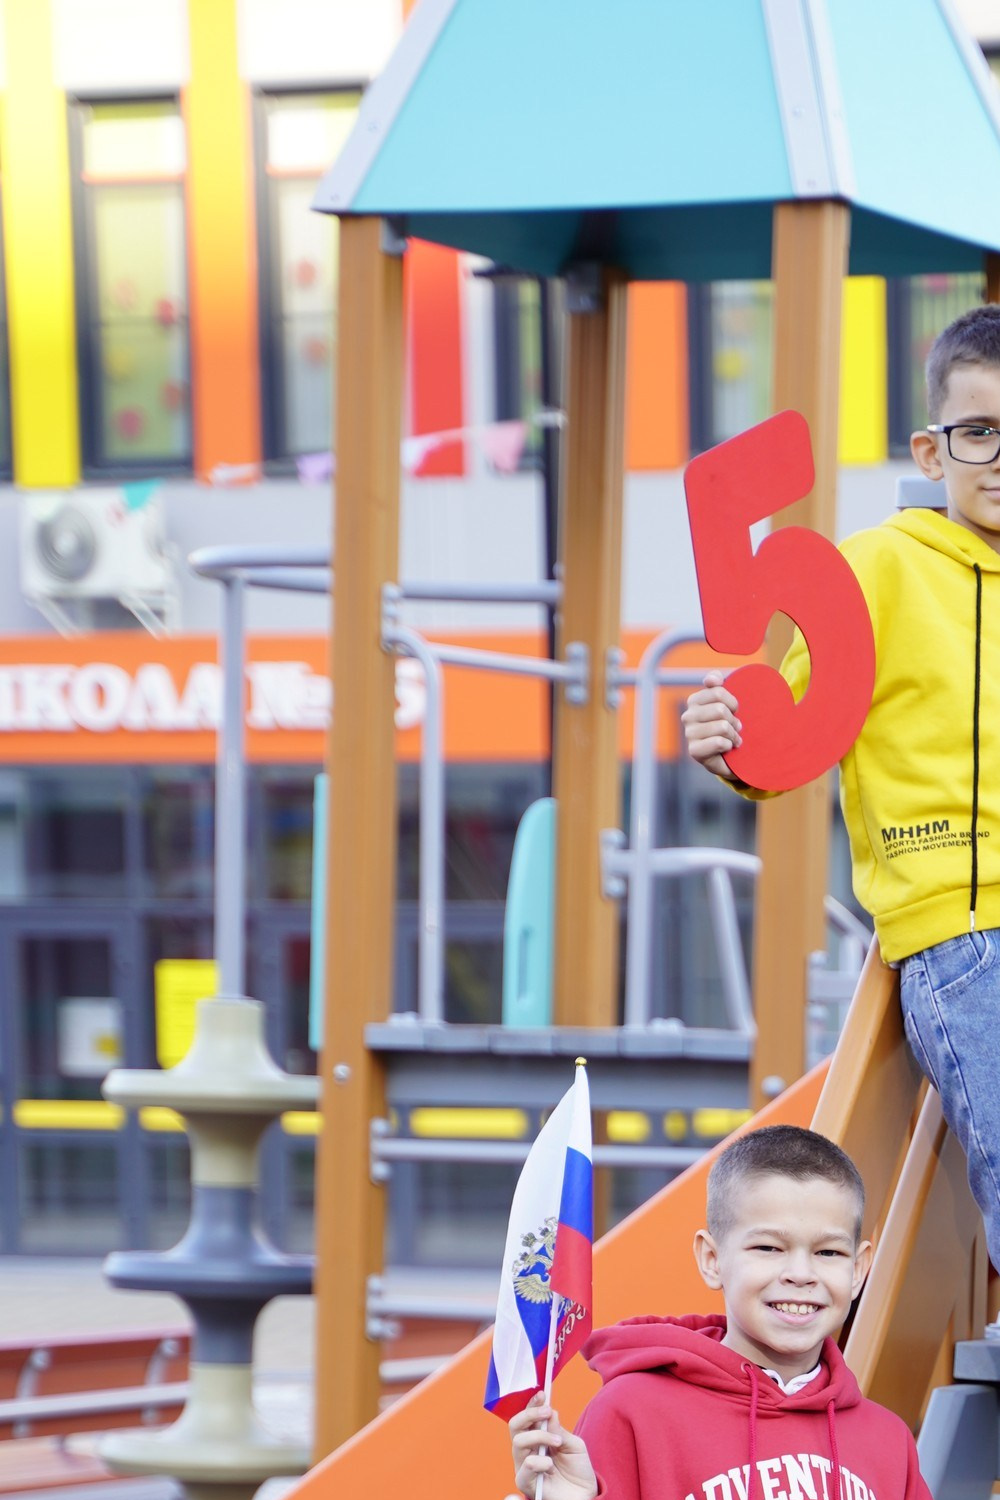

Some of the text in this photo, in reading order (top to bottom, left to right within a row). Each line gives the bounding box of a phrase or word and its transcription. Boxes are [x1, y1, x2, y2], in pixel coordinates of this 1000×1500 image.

[684, 409, 876, 792] 5
[0, 663, 222, 732] КОЛА
[881, 819, 950, 844] MHHM
[884, 831, 991, 853] SPORTS FASHION BRND
[886, 840, 973, 861] FASHION MOVEMENT
